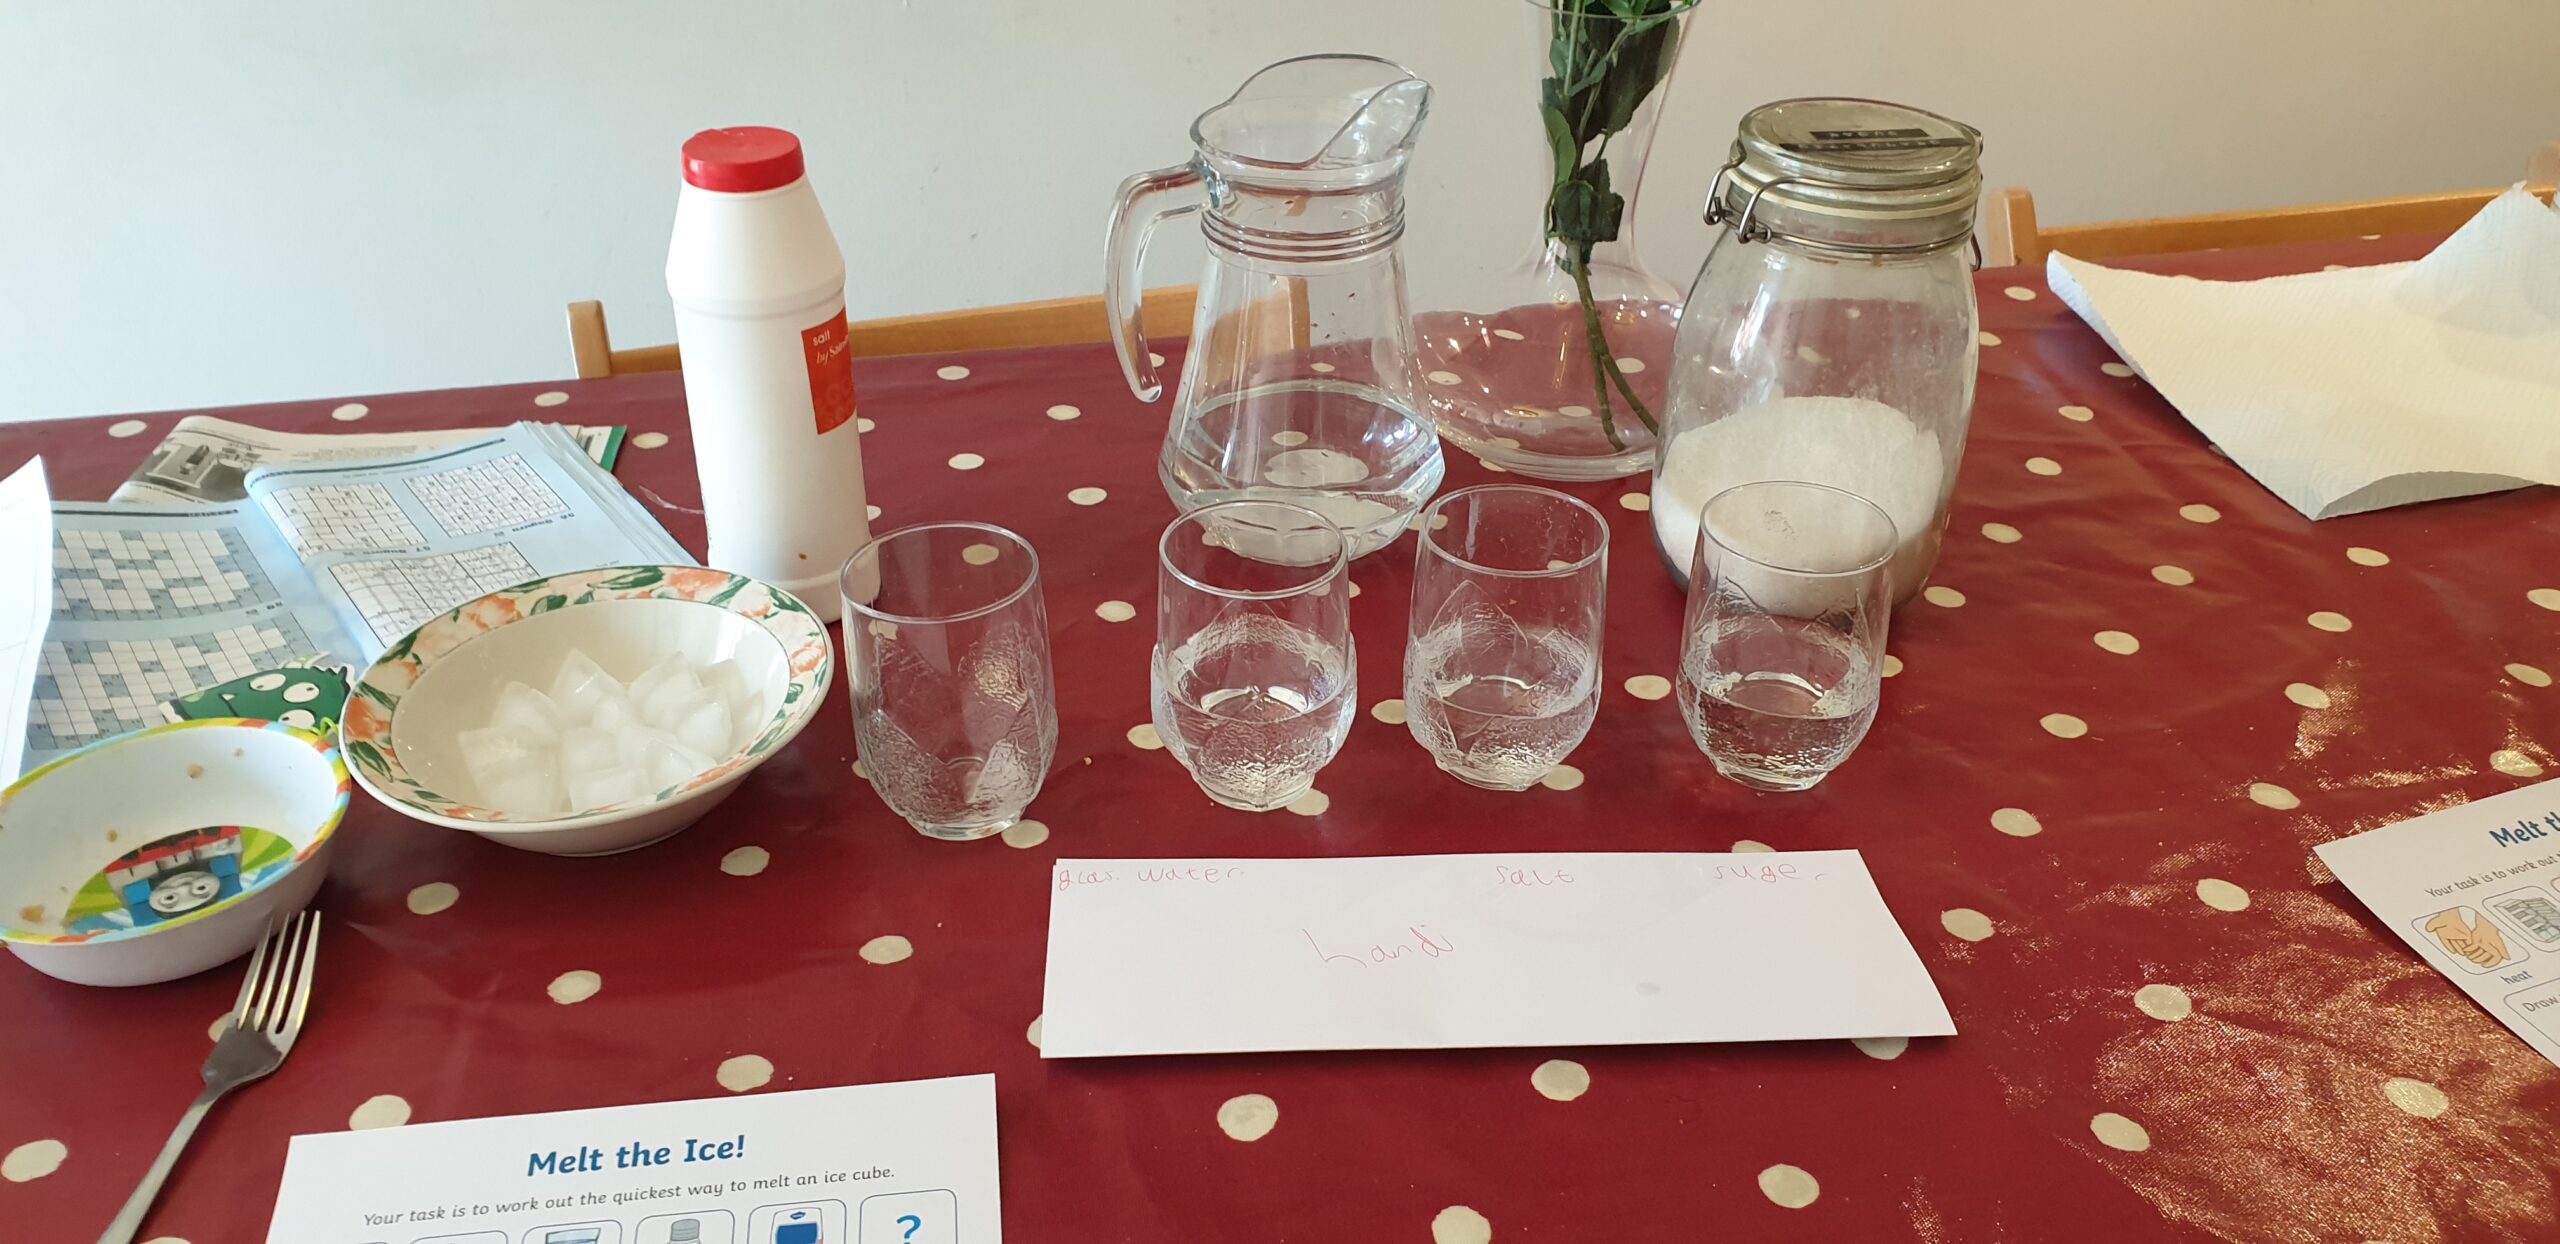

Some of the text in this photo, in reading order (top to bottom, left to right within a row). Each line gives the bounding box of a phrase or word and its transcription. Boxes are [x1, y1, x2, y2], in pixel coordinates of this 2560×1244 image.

[812, 328, 831, 346] salt
[815, 350, 829, 367] by
[2488, 820, 2548, 848] Melt
[2425, 855, 2558, 898] Your task is to work out
[2500, 970, 2534, 985] heat
[2522, 996, 2559, 1013] Draw
[527, 1134, 745, 1177] Melt the Ice!
[364, 1166, 895, 1227] Your task is to work out the quickest way to melt an ice cube.
